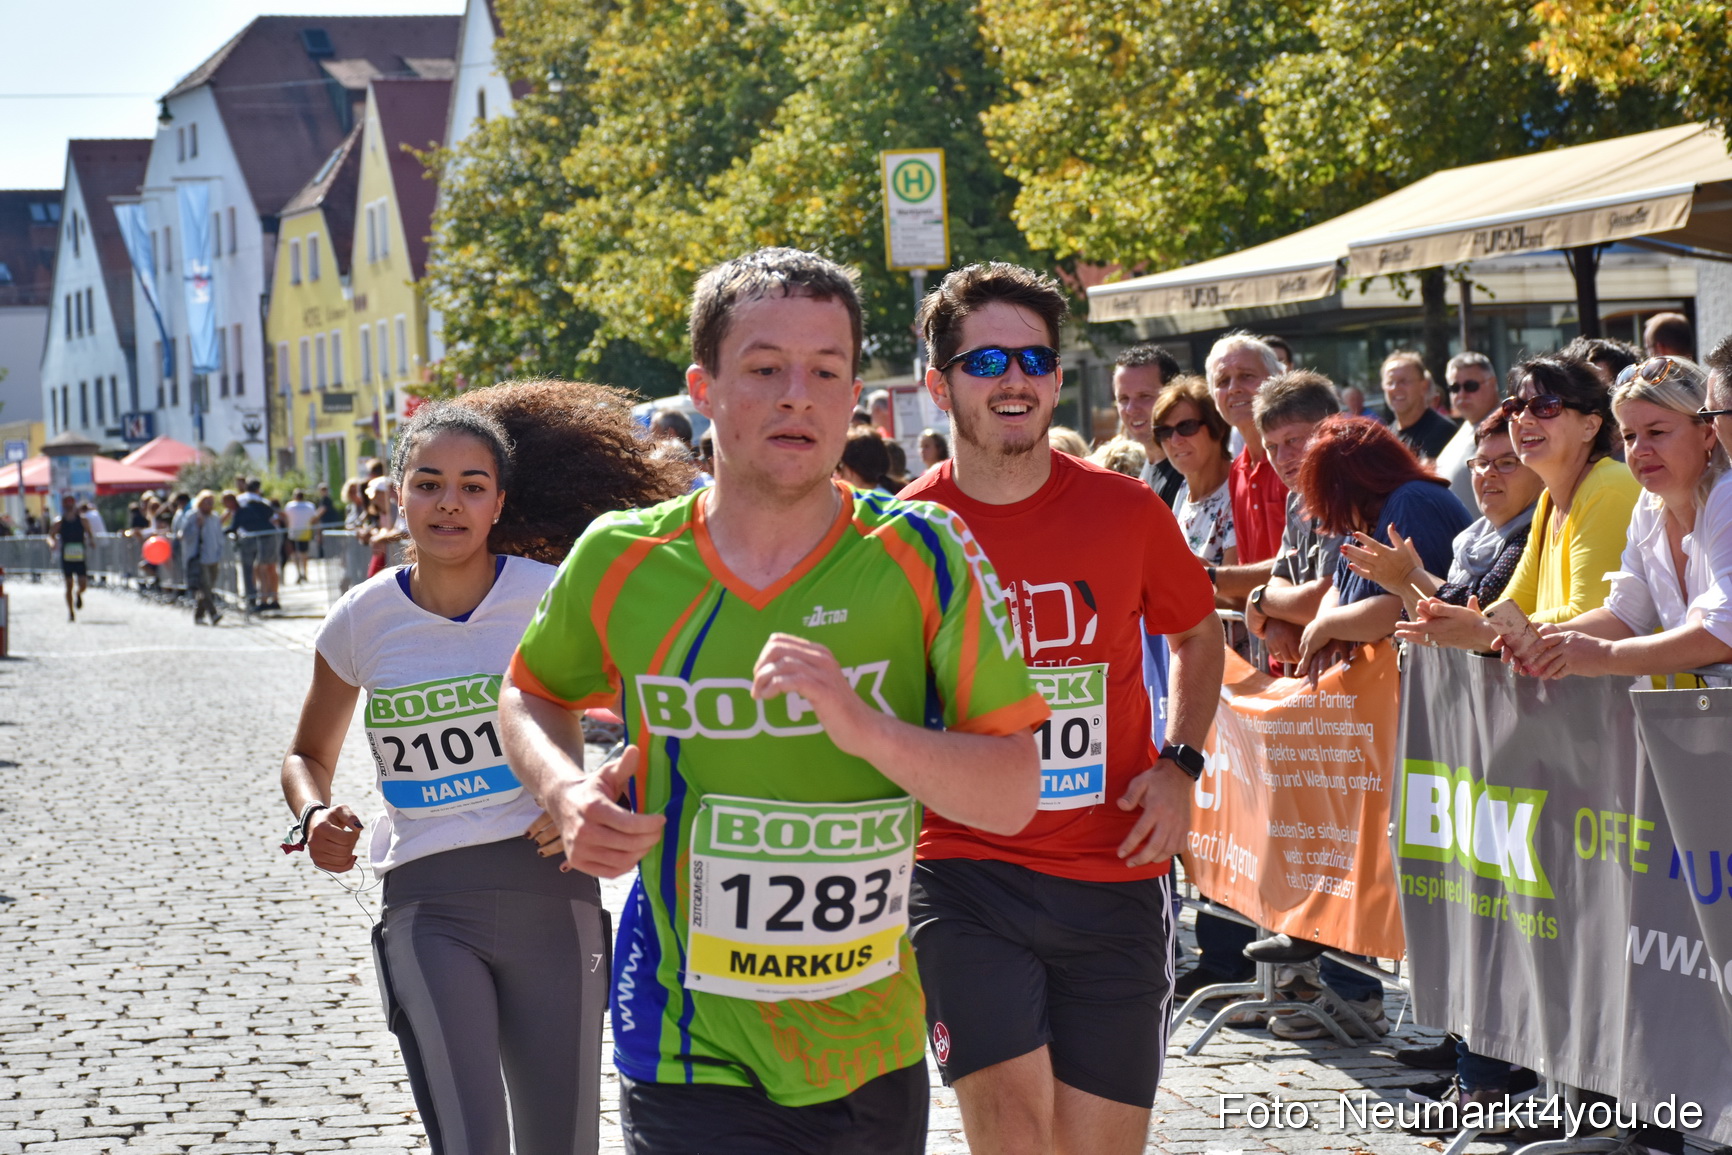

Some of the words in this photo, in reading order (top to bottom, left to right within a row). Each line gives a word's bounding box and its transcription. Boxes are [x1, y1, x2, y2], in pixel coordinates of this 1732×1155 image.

[904, 170, 924, 192] H
[370, 676, 498, 723] BOCK
[1319, 690, 1357, 709] Partner
[1093, 717, 1100, 726] D
[1297, 717, 1314, 735] und
[1316, 718, 1374, 742] Umsetzung
[382, 721, 503, 773] 2101
[1033, 717, 1090, 760] 10
[1297, 747, 1318, 761] was
[421, 775, 491, 803] HANA
[1282, 769, 1303, 788] und
[1303, 770, 1348, 795] Werbung
[710, 805, 909, 856] BOCK
[1297, 822, 1315, 839] Sie
[1283, 846, 1305, 865] web:
[720, 868, 892, 932] 1283
[729, 944, 873, 978] MARKUS
